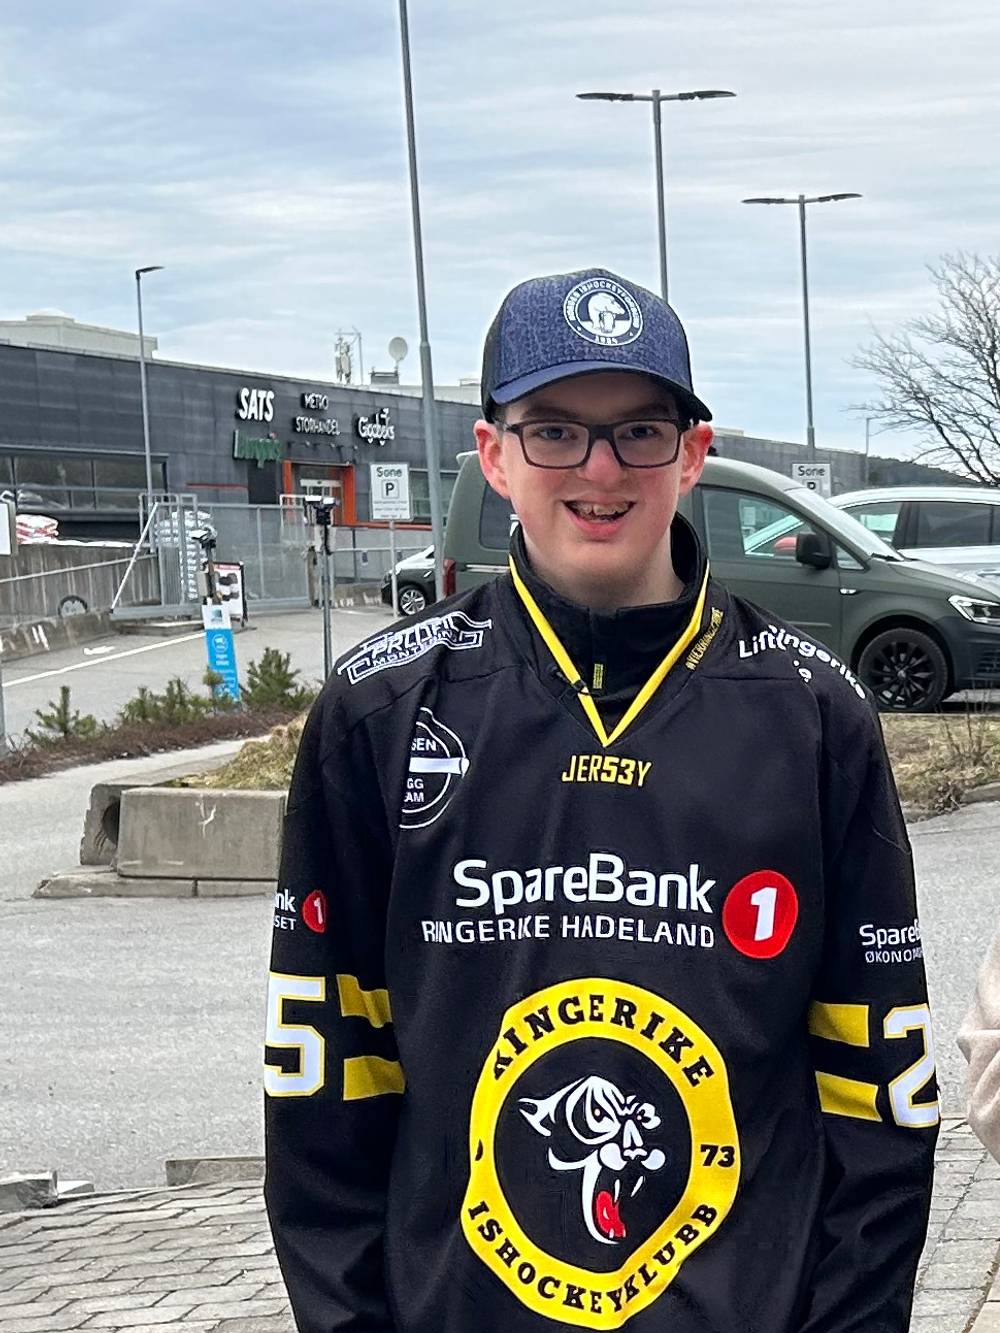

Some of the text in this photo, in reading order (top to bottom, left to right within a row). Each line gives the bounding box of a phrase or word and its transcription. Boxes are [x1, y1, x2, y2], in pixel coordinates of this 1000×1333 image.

[239, 387, 274, 422] SATS
[376, 466, 402, 477] Sone
[798, 465, 825, 477] Sone
[385, 482, 395, 496] P
[561, 755, 653, 787] JER53Y
[453, 853, 777, 941] SpareBank 1
[421, 914, 715, 948] RINGERIKE HADELAND
[264, 970, 326, 1098] 5
[883, 1003, 940, 1128] 2
[700, 1144, 736, 1168] 73
[468, 1200, 718, 1314] ISHOCKEYKLUBB
